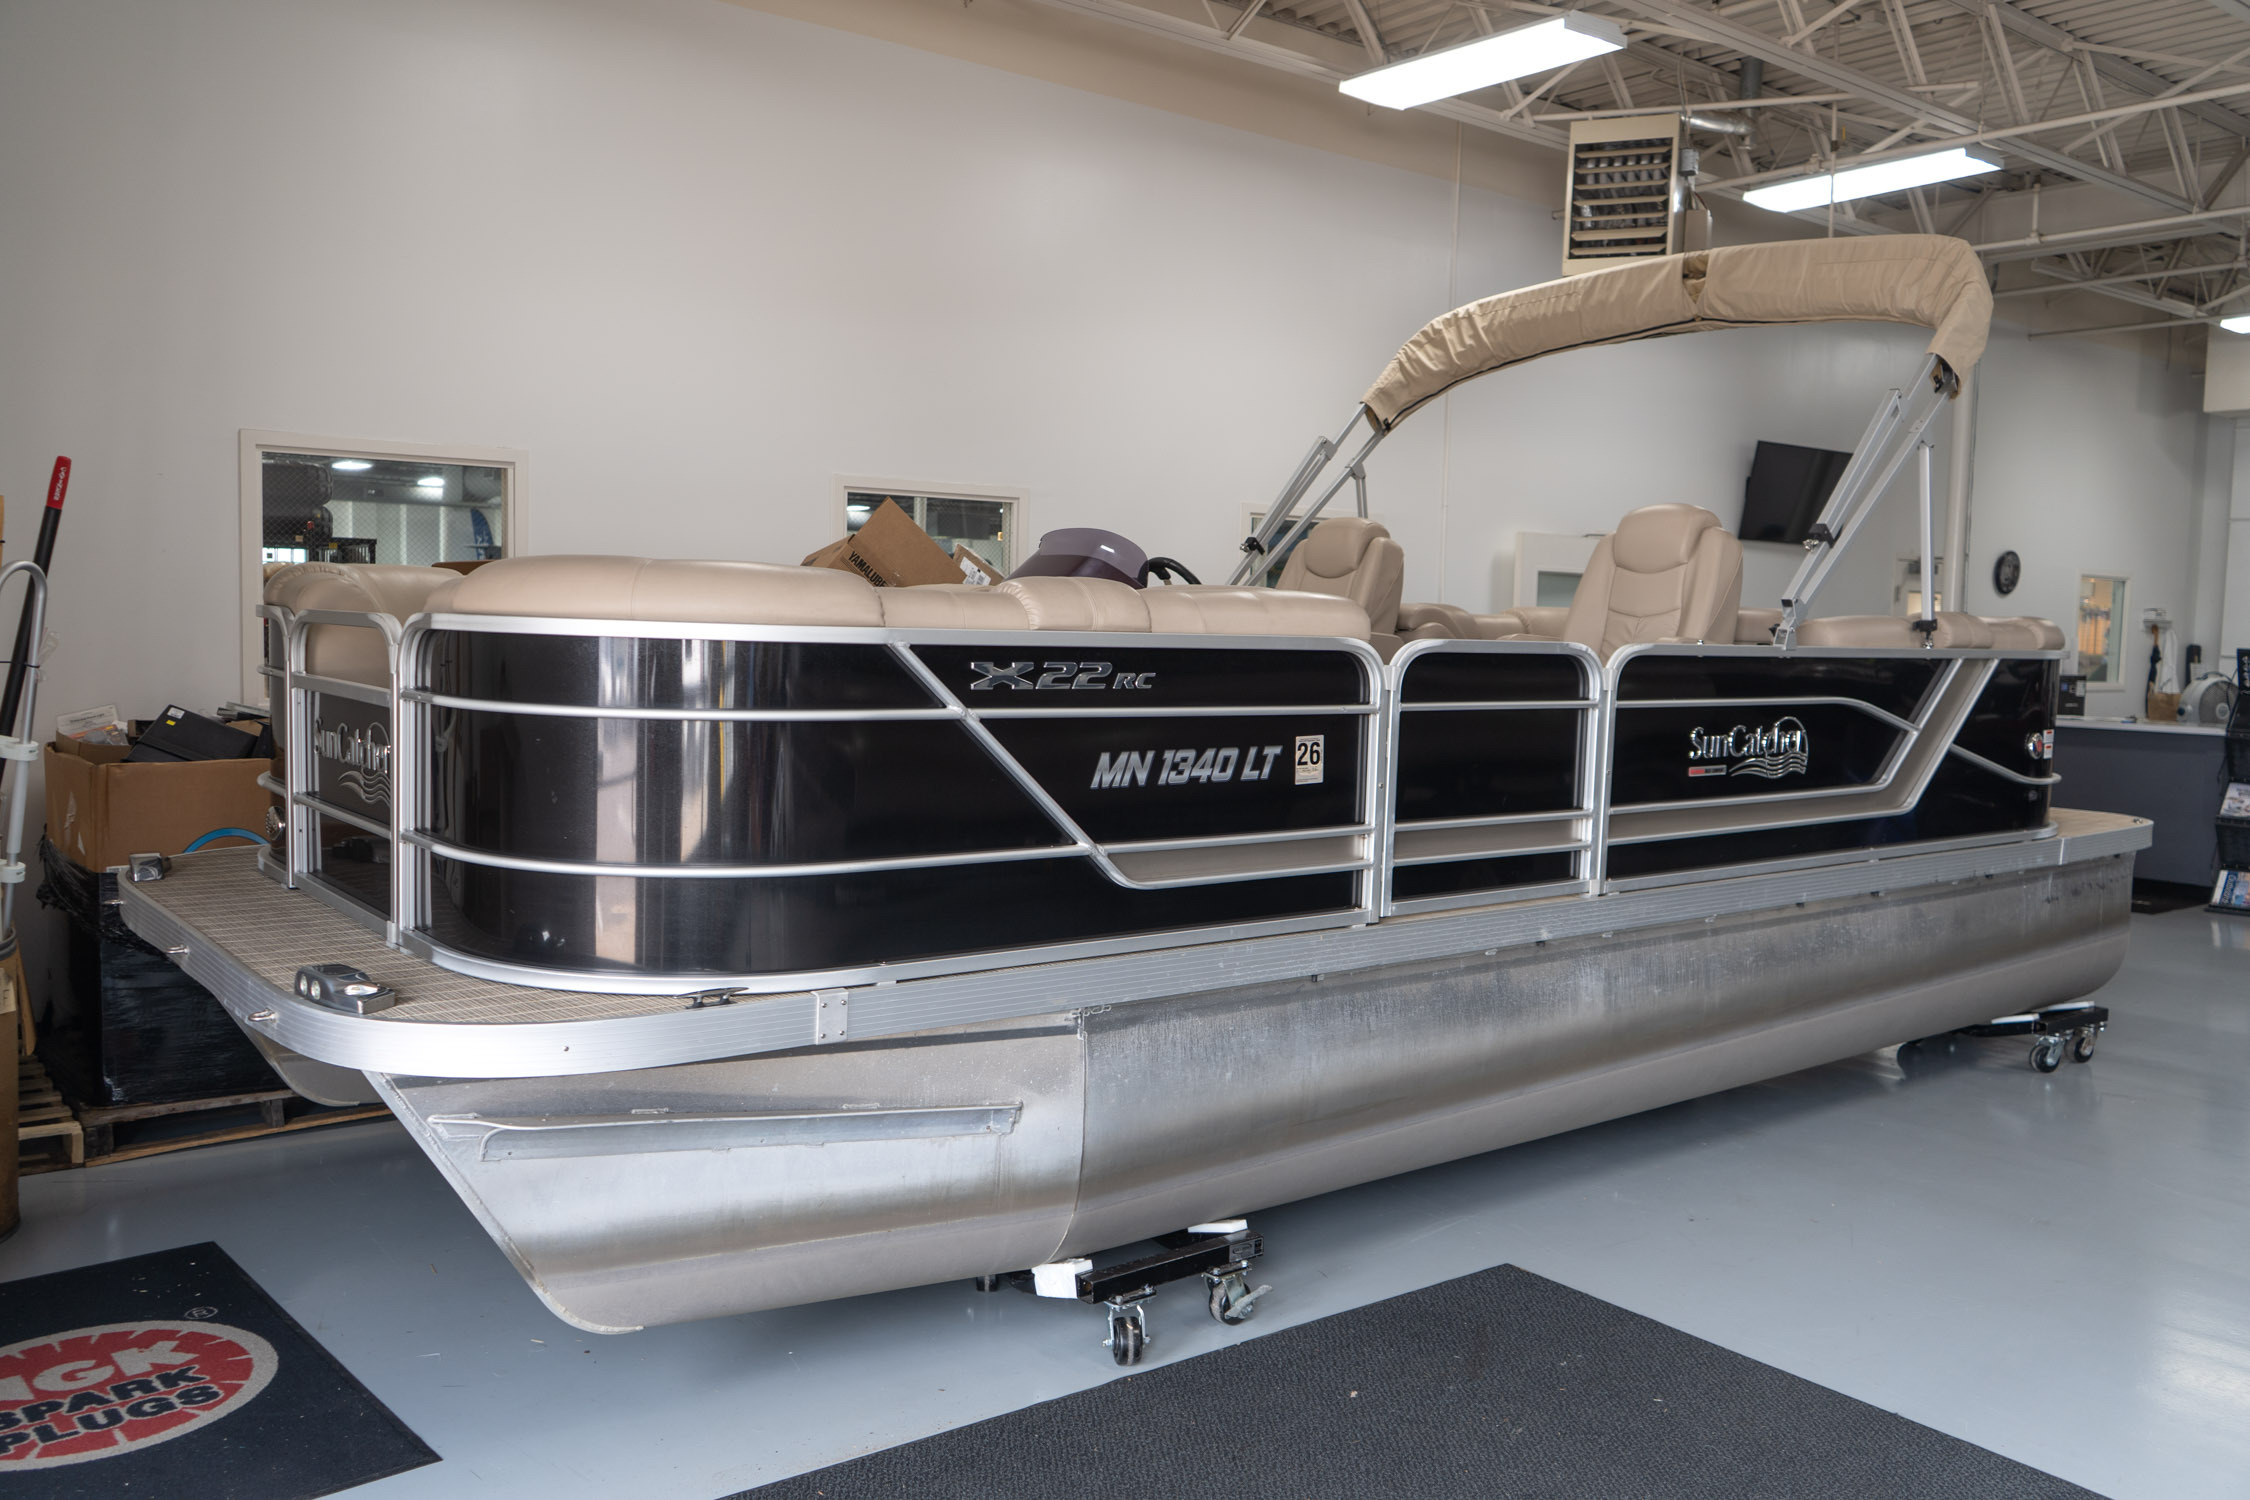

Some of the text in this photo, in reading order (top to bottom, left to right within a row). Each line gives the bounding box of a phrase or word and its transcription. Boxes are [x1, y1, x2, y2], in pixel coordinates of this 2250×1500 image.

[970, 661, 1157, 690] X22 RC
[1297, 741, 1321, 766] 26
[1688, 719, 1807, 759] SunCatcher
[1090, 745, 1284, 789] MN 1340 LT
